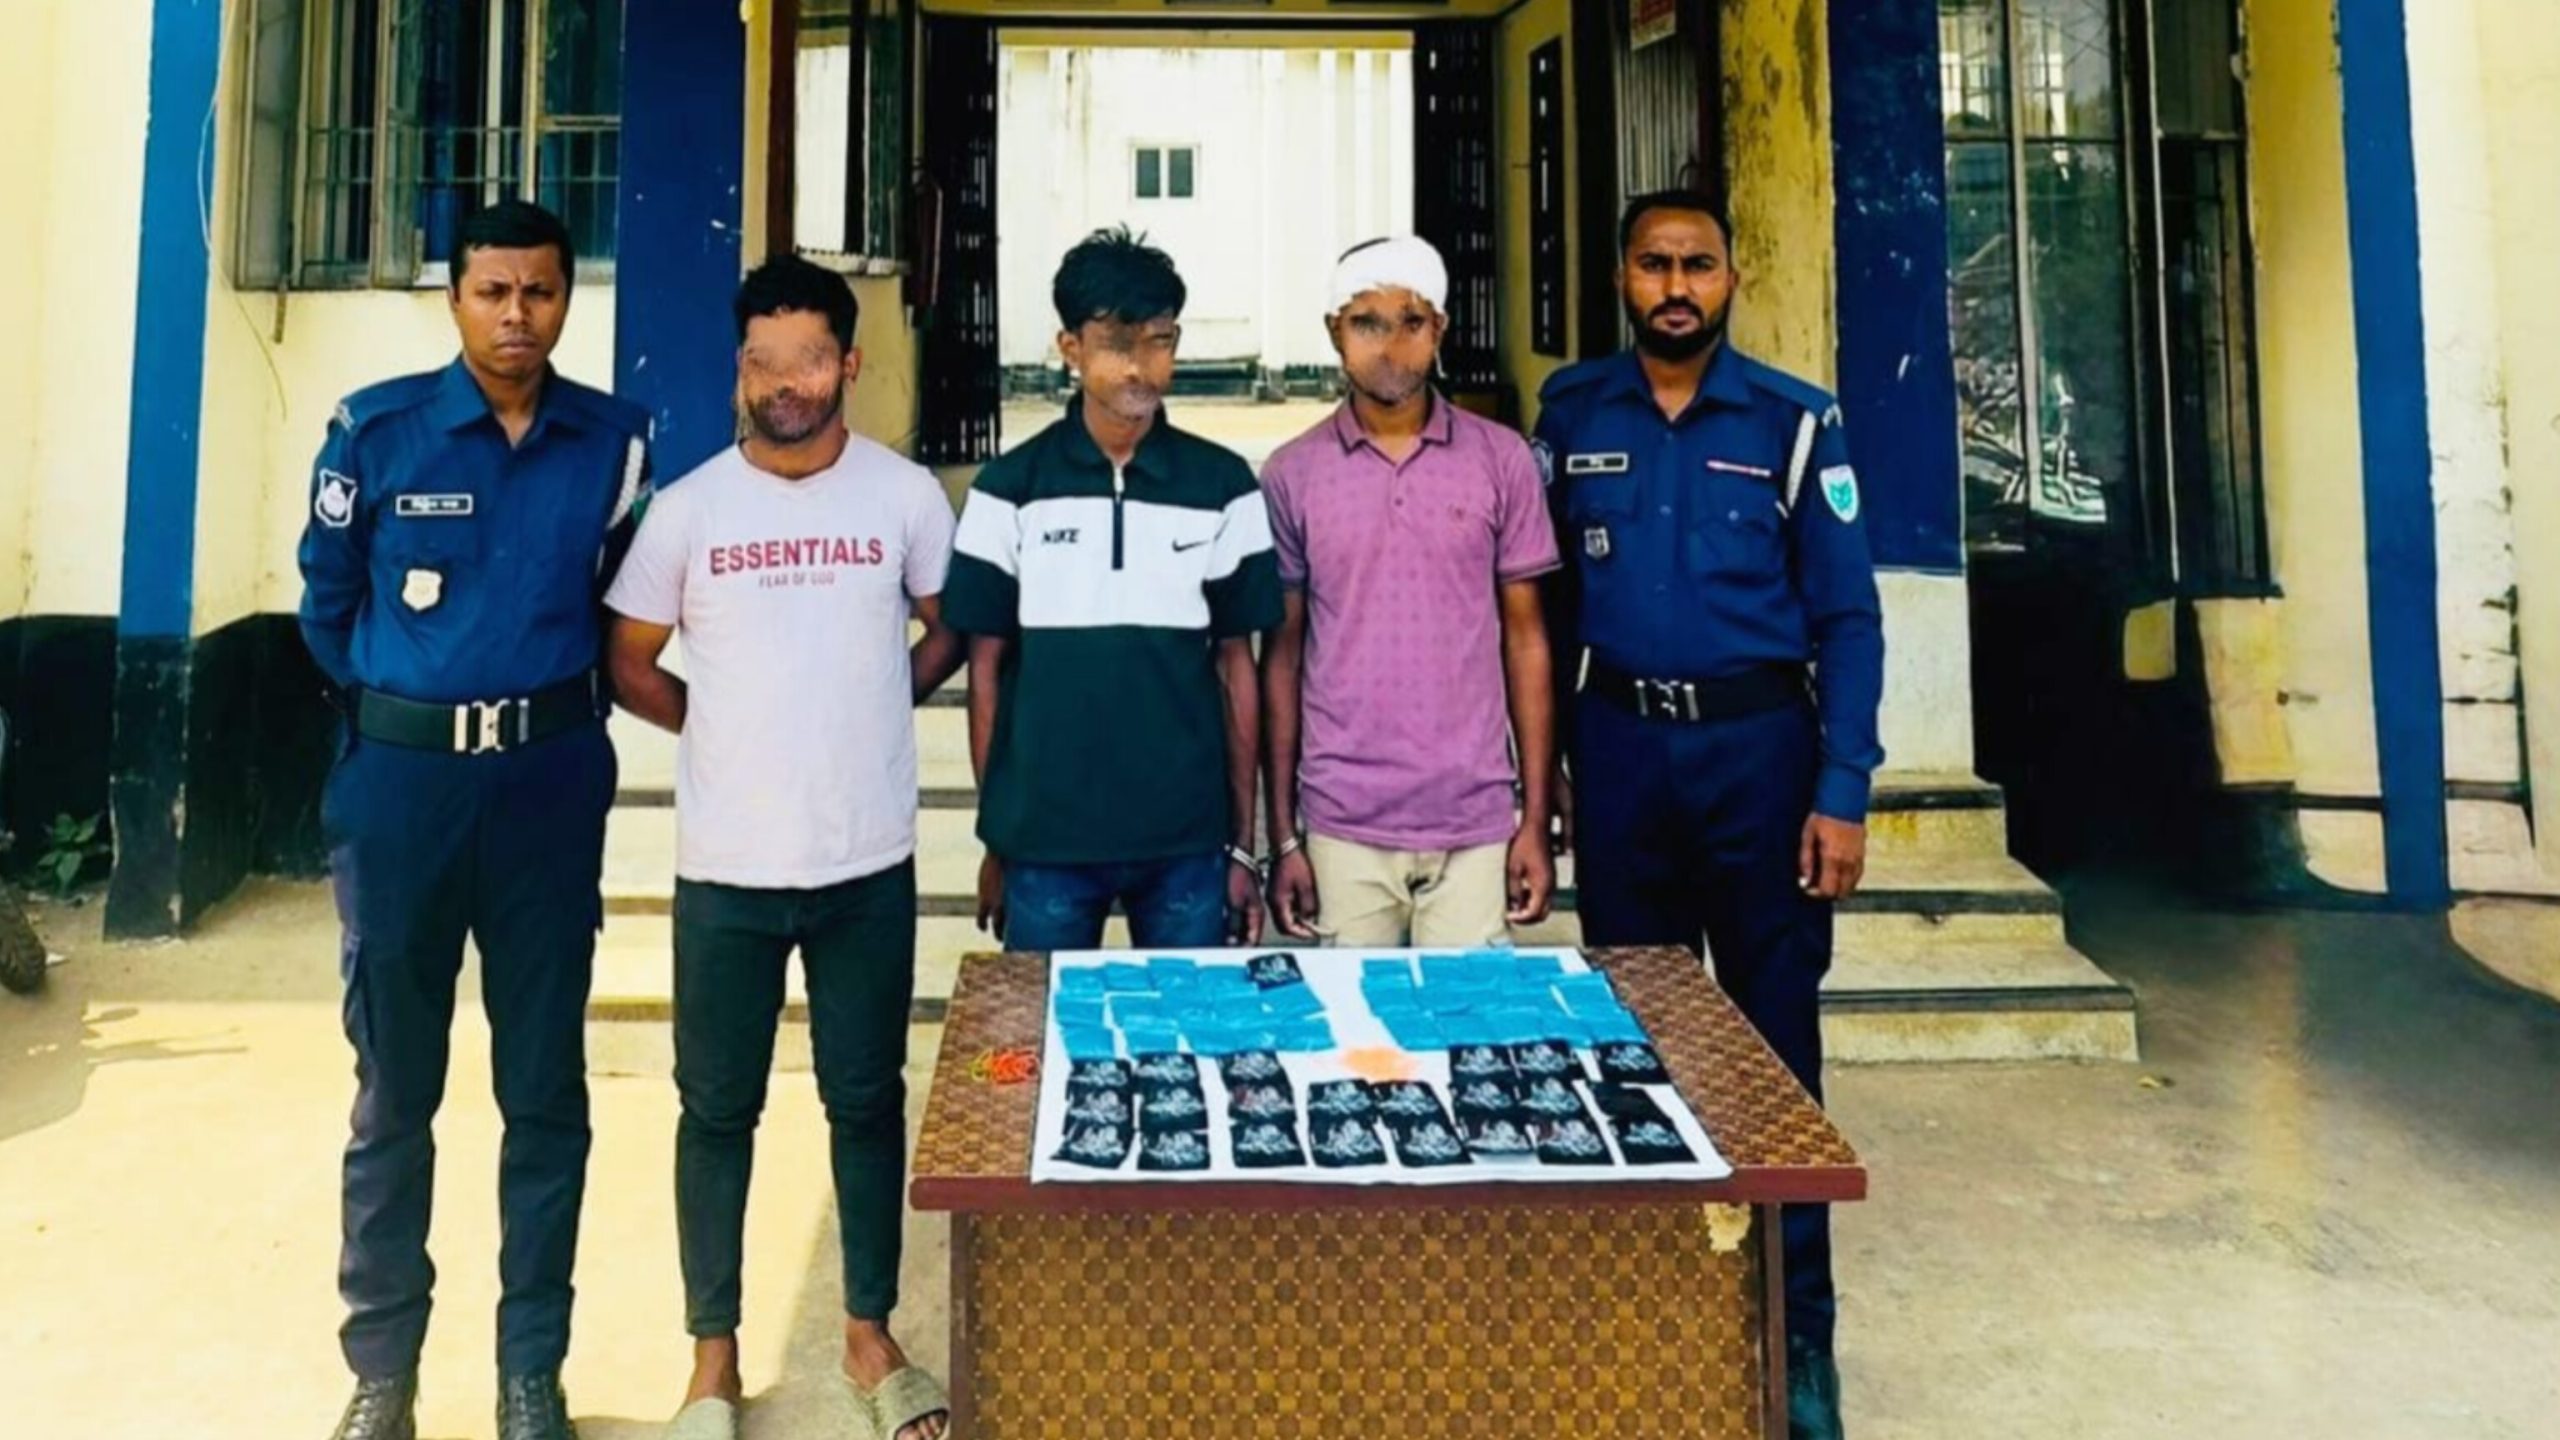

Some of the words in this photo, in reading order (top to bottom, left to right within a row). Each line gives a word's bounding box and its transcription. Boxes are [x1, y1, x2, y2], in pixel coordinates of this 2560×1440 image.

[1042, 528, 1080, 544] NIKE
[710, 537, 883, 576] ESSENTIALS
[759, 574, 789, 588] FEAR
[793, 572, 808, 586] OF
